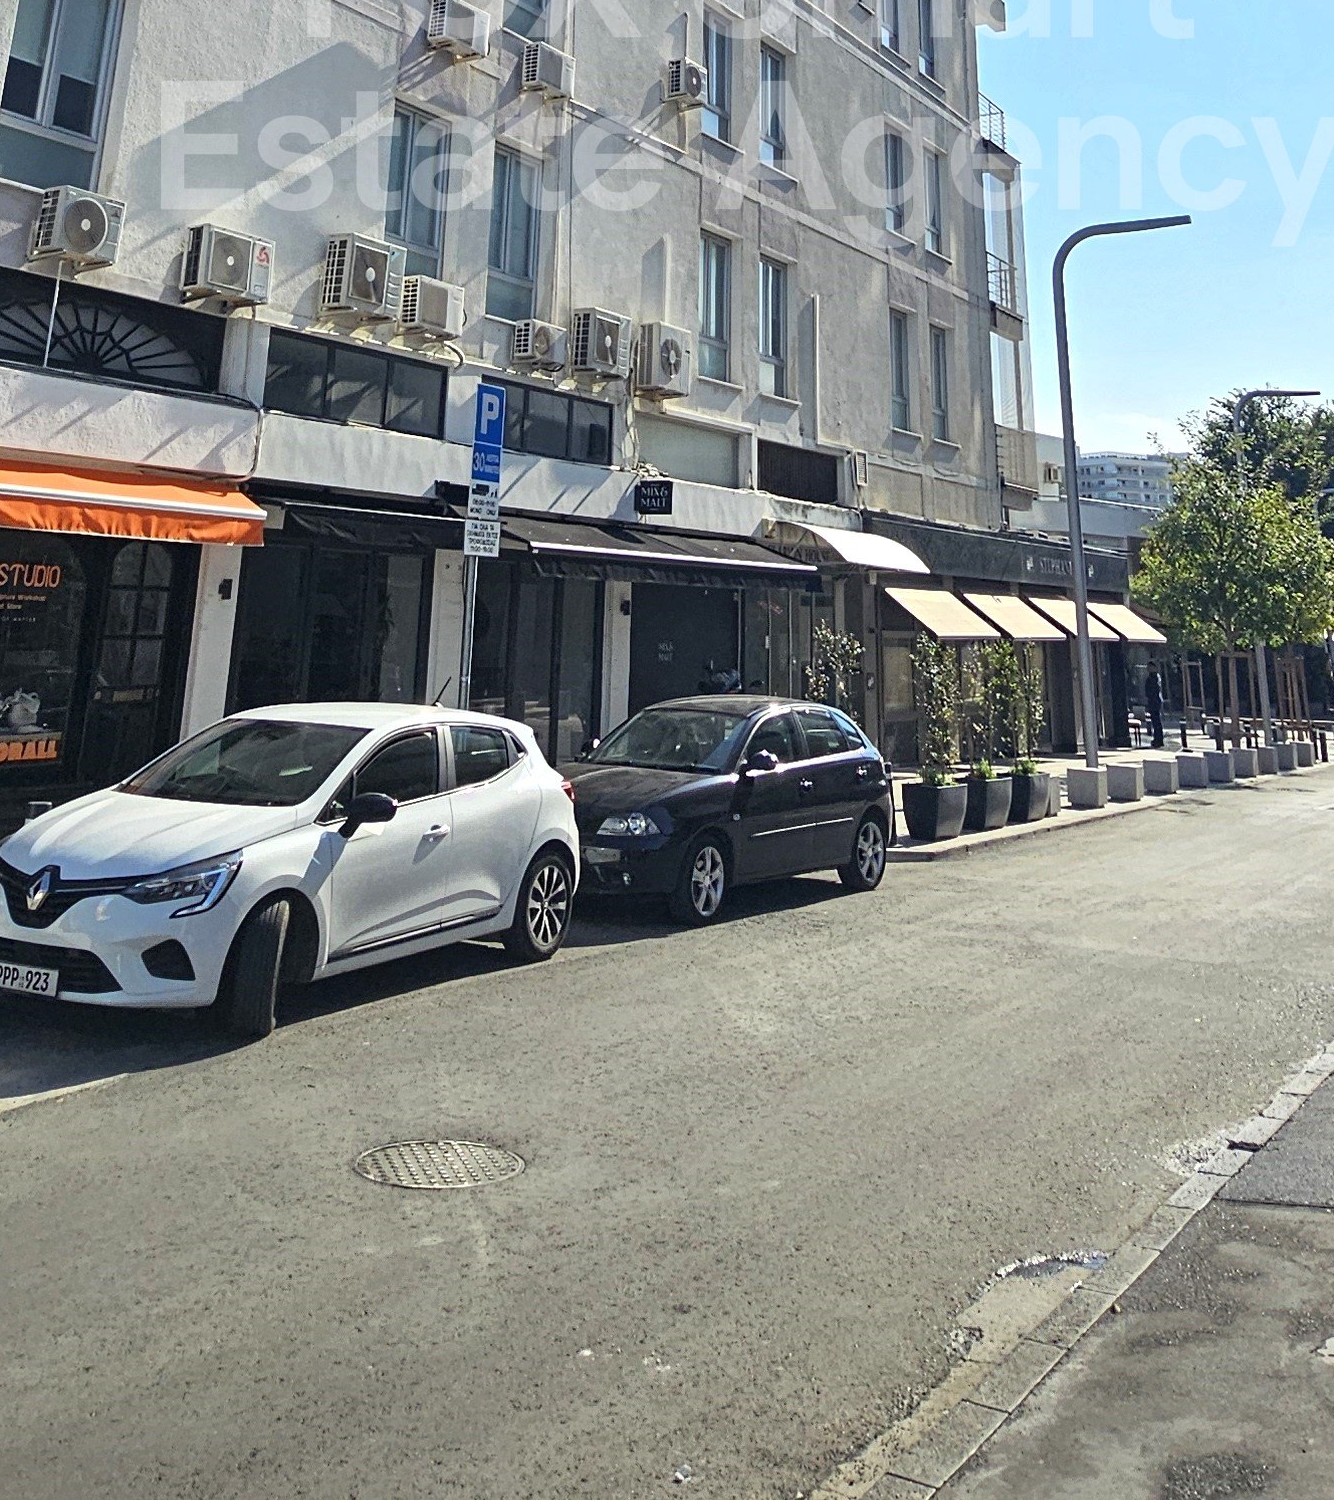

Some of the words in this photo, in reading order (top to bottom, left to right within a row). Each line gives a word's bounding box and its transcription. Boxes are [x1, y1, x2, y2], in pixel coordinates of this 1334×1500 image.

[480, 392, 500, 435] P
[473, 451, 486, 473] 30
[25, 970, 50, 992] 923
